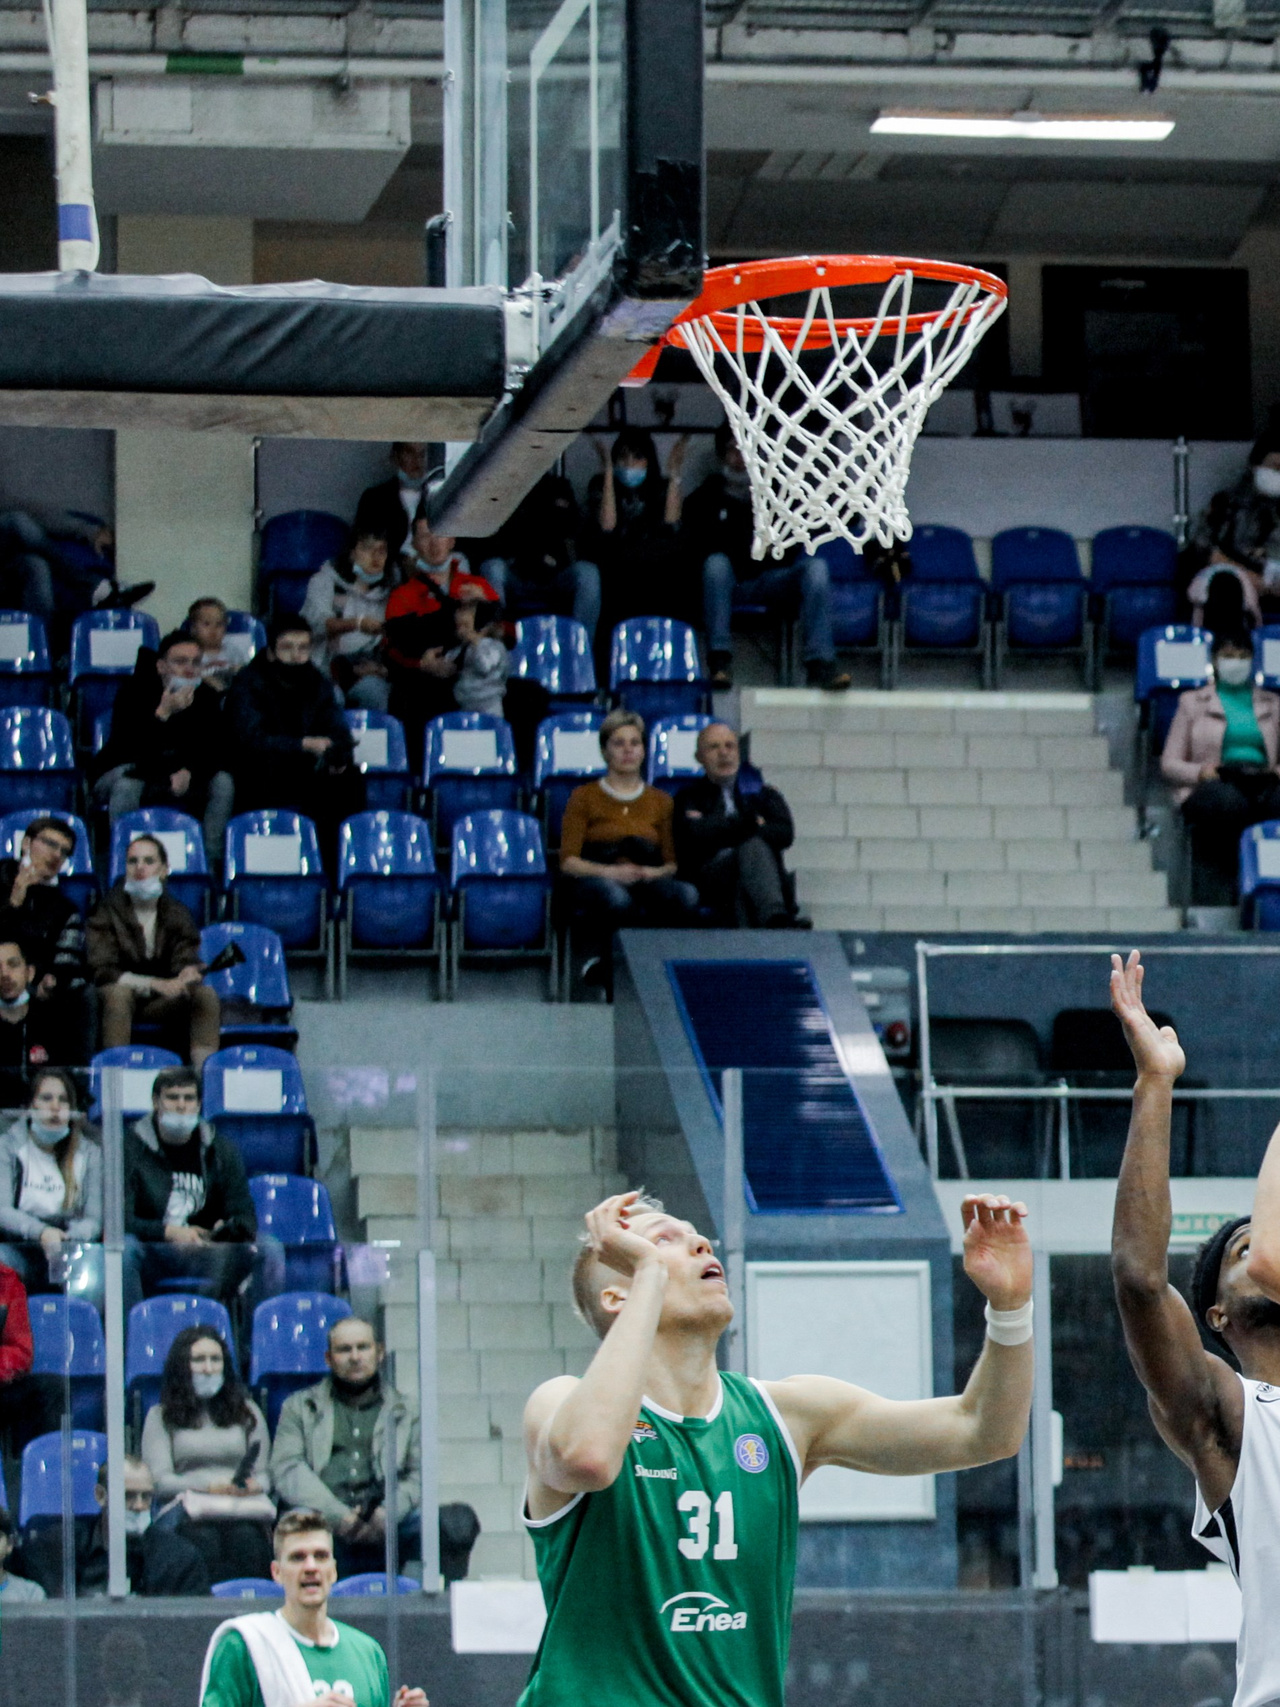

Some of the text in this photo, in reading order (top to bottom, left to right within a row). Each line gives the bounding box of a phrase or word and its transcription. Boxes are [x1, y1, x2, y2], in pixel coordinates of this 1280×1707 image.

[634, 1464, 678, 1480] SPALDING
[677, 1490, 738, 1560] 31
[670, 1607, 747, 1632] Enea
